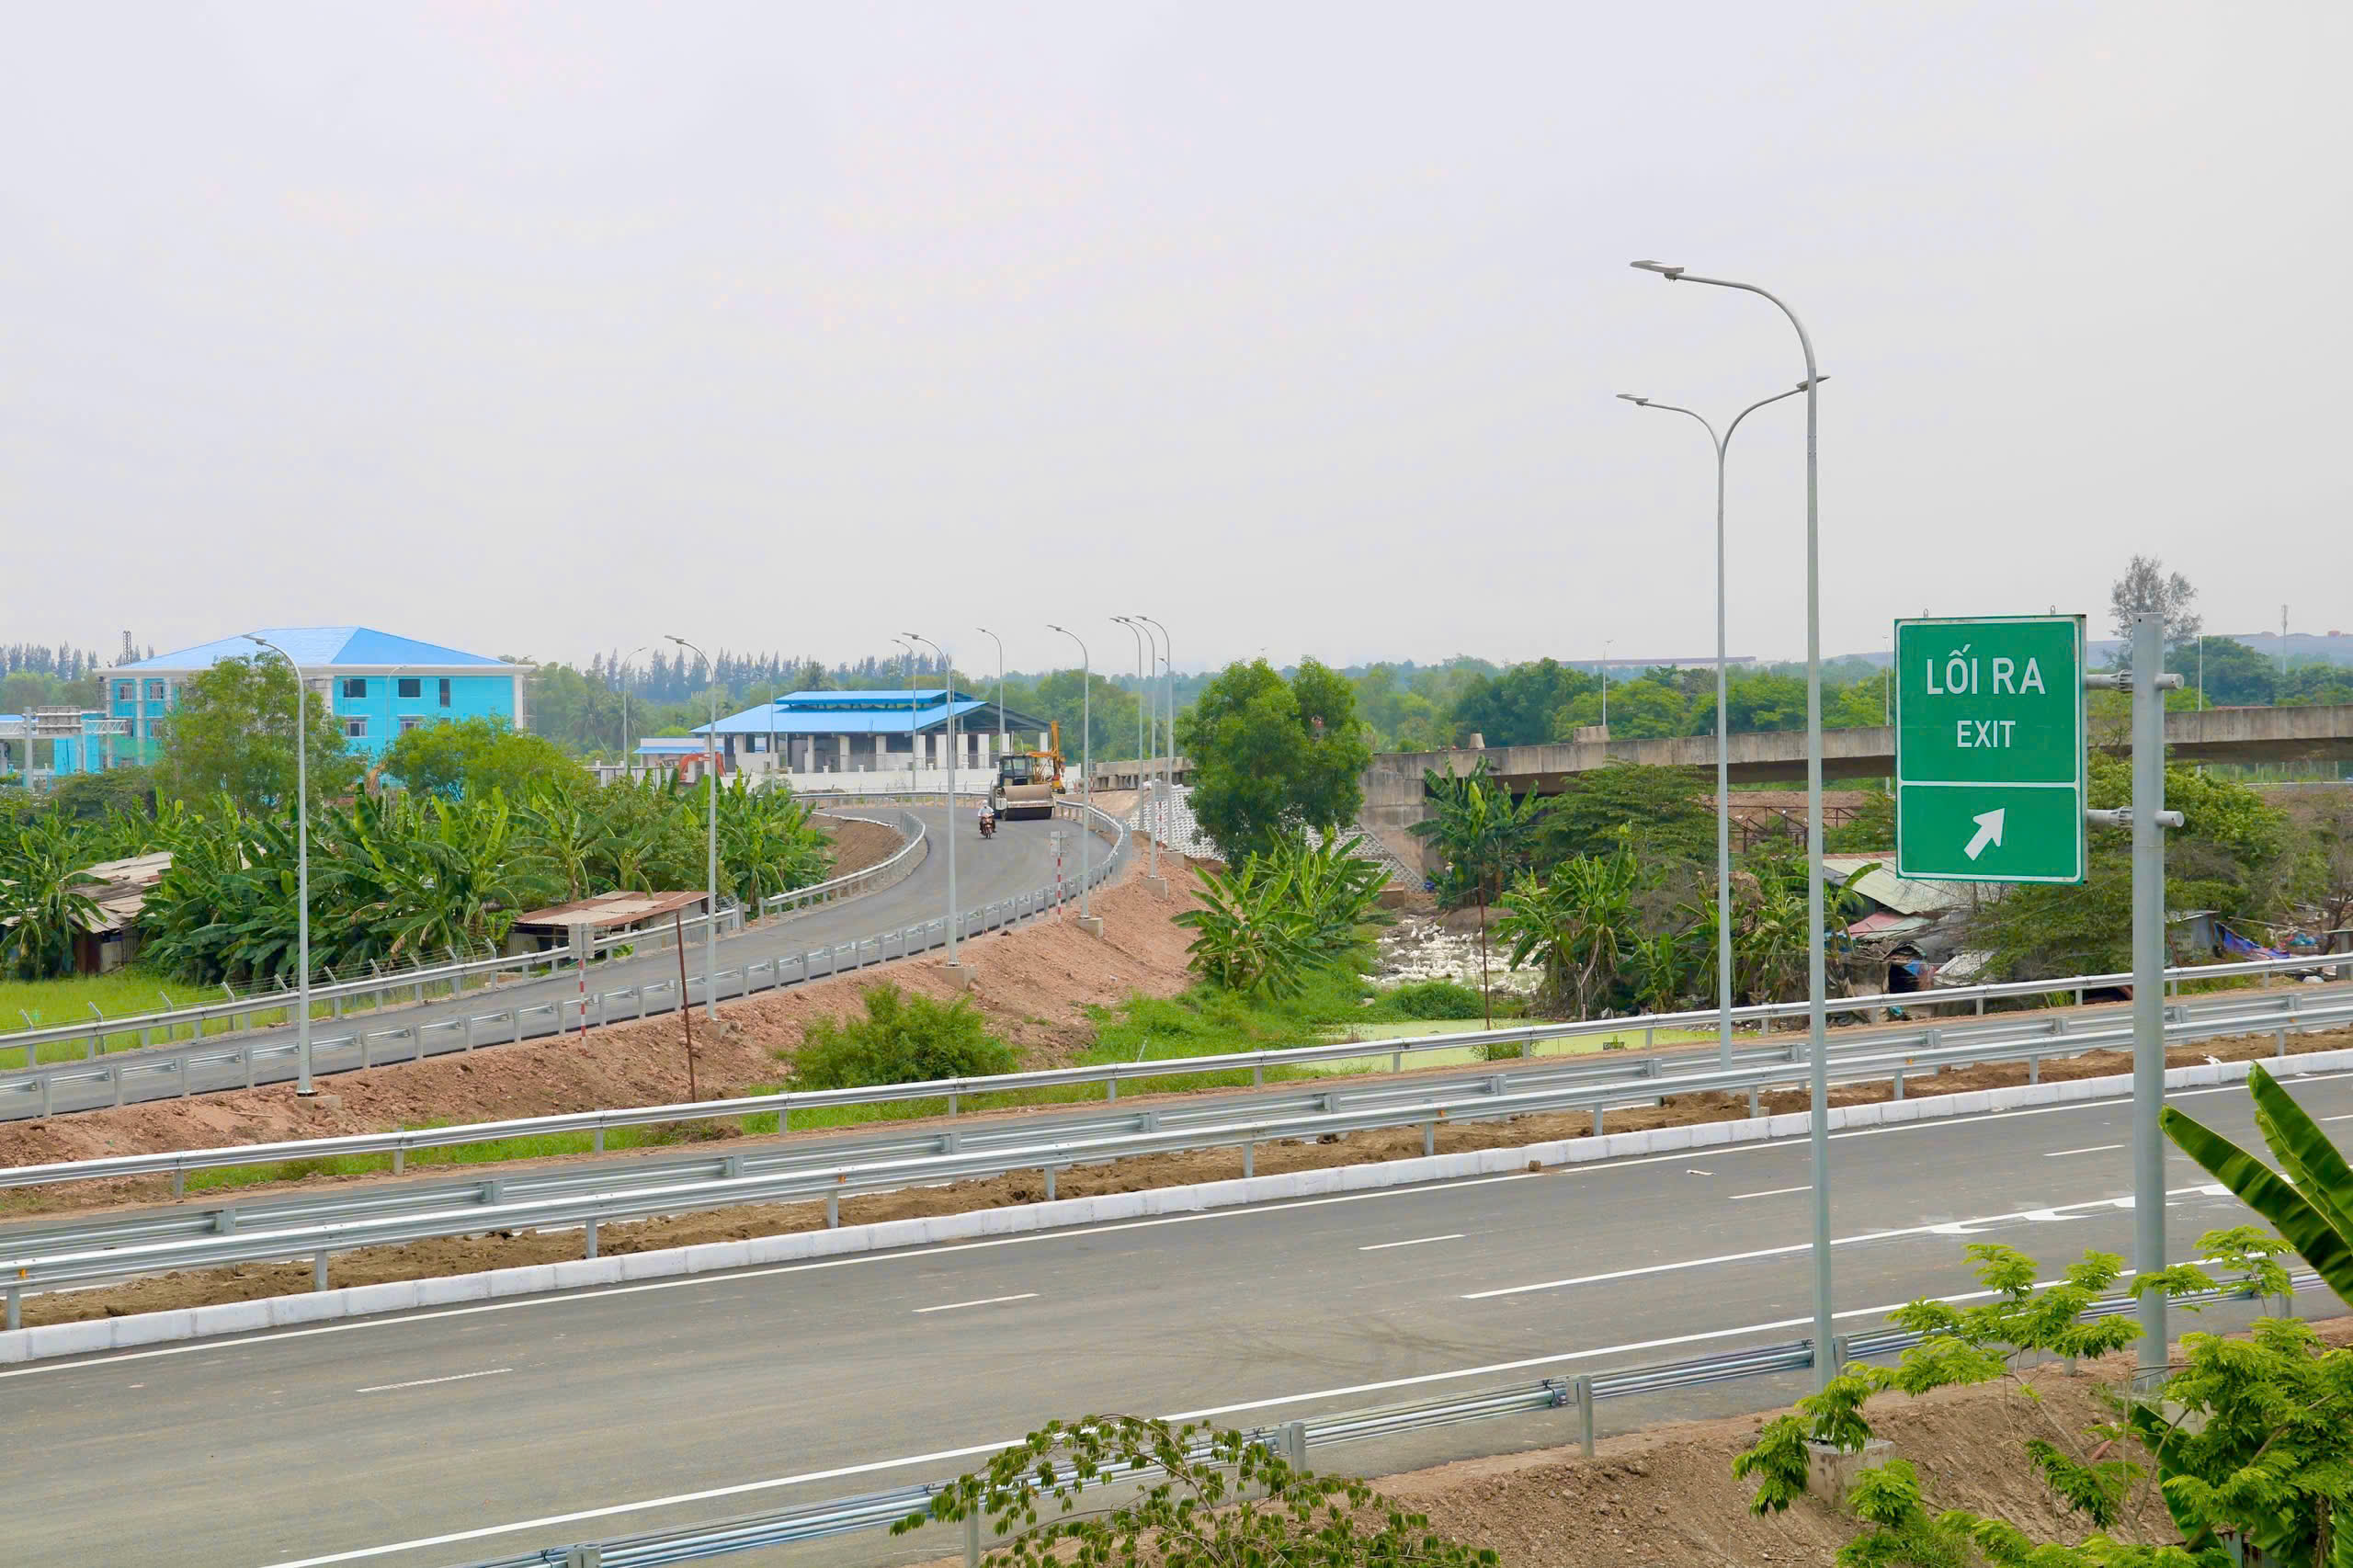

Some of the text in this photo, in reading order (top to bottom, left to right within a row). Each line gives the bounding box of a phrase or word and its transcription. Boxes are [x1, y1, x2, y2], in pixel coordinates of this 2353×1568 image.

[1927, 643, 2046, 695] LỐI RA
[1957, 720, 2016, 747] EXIT
